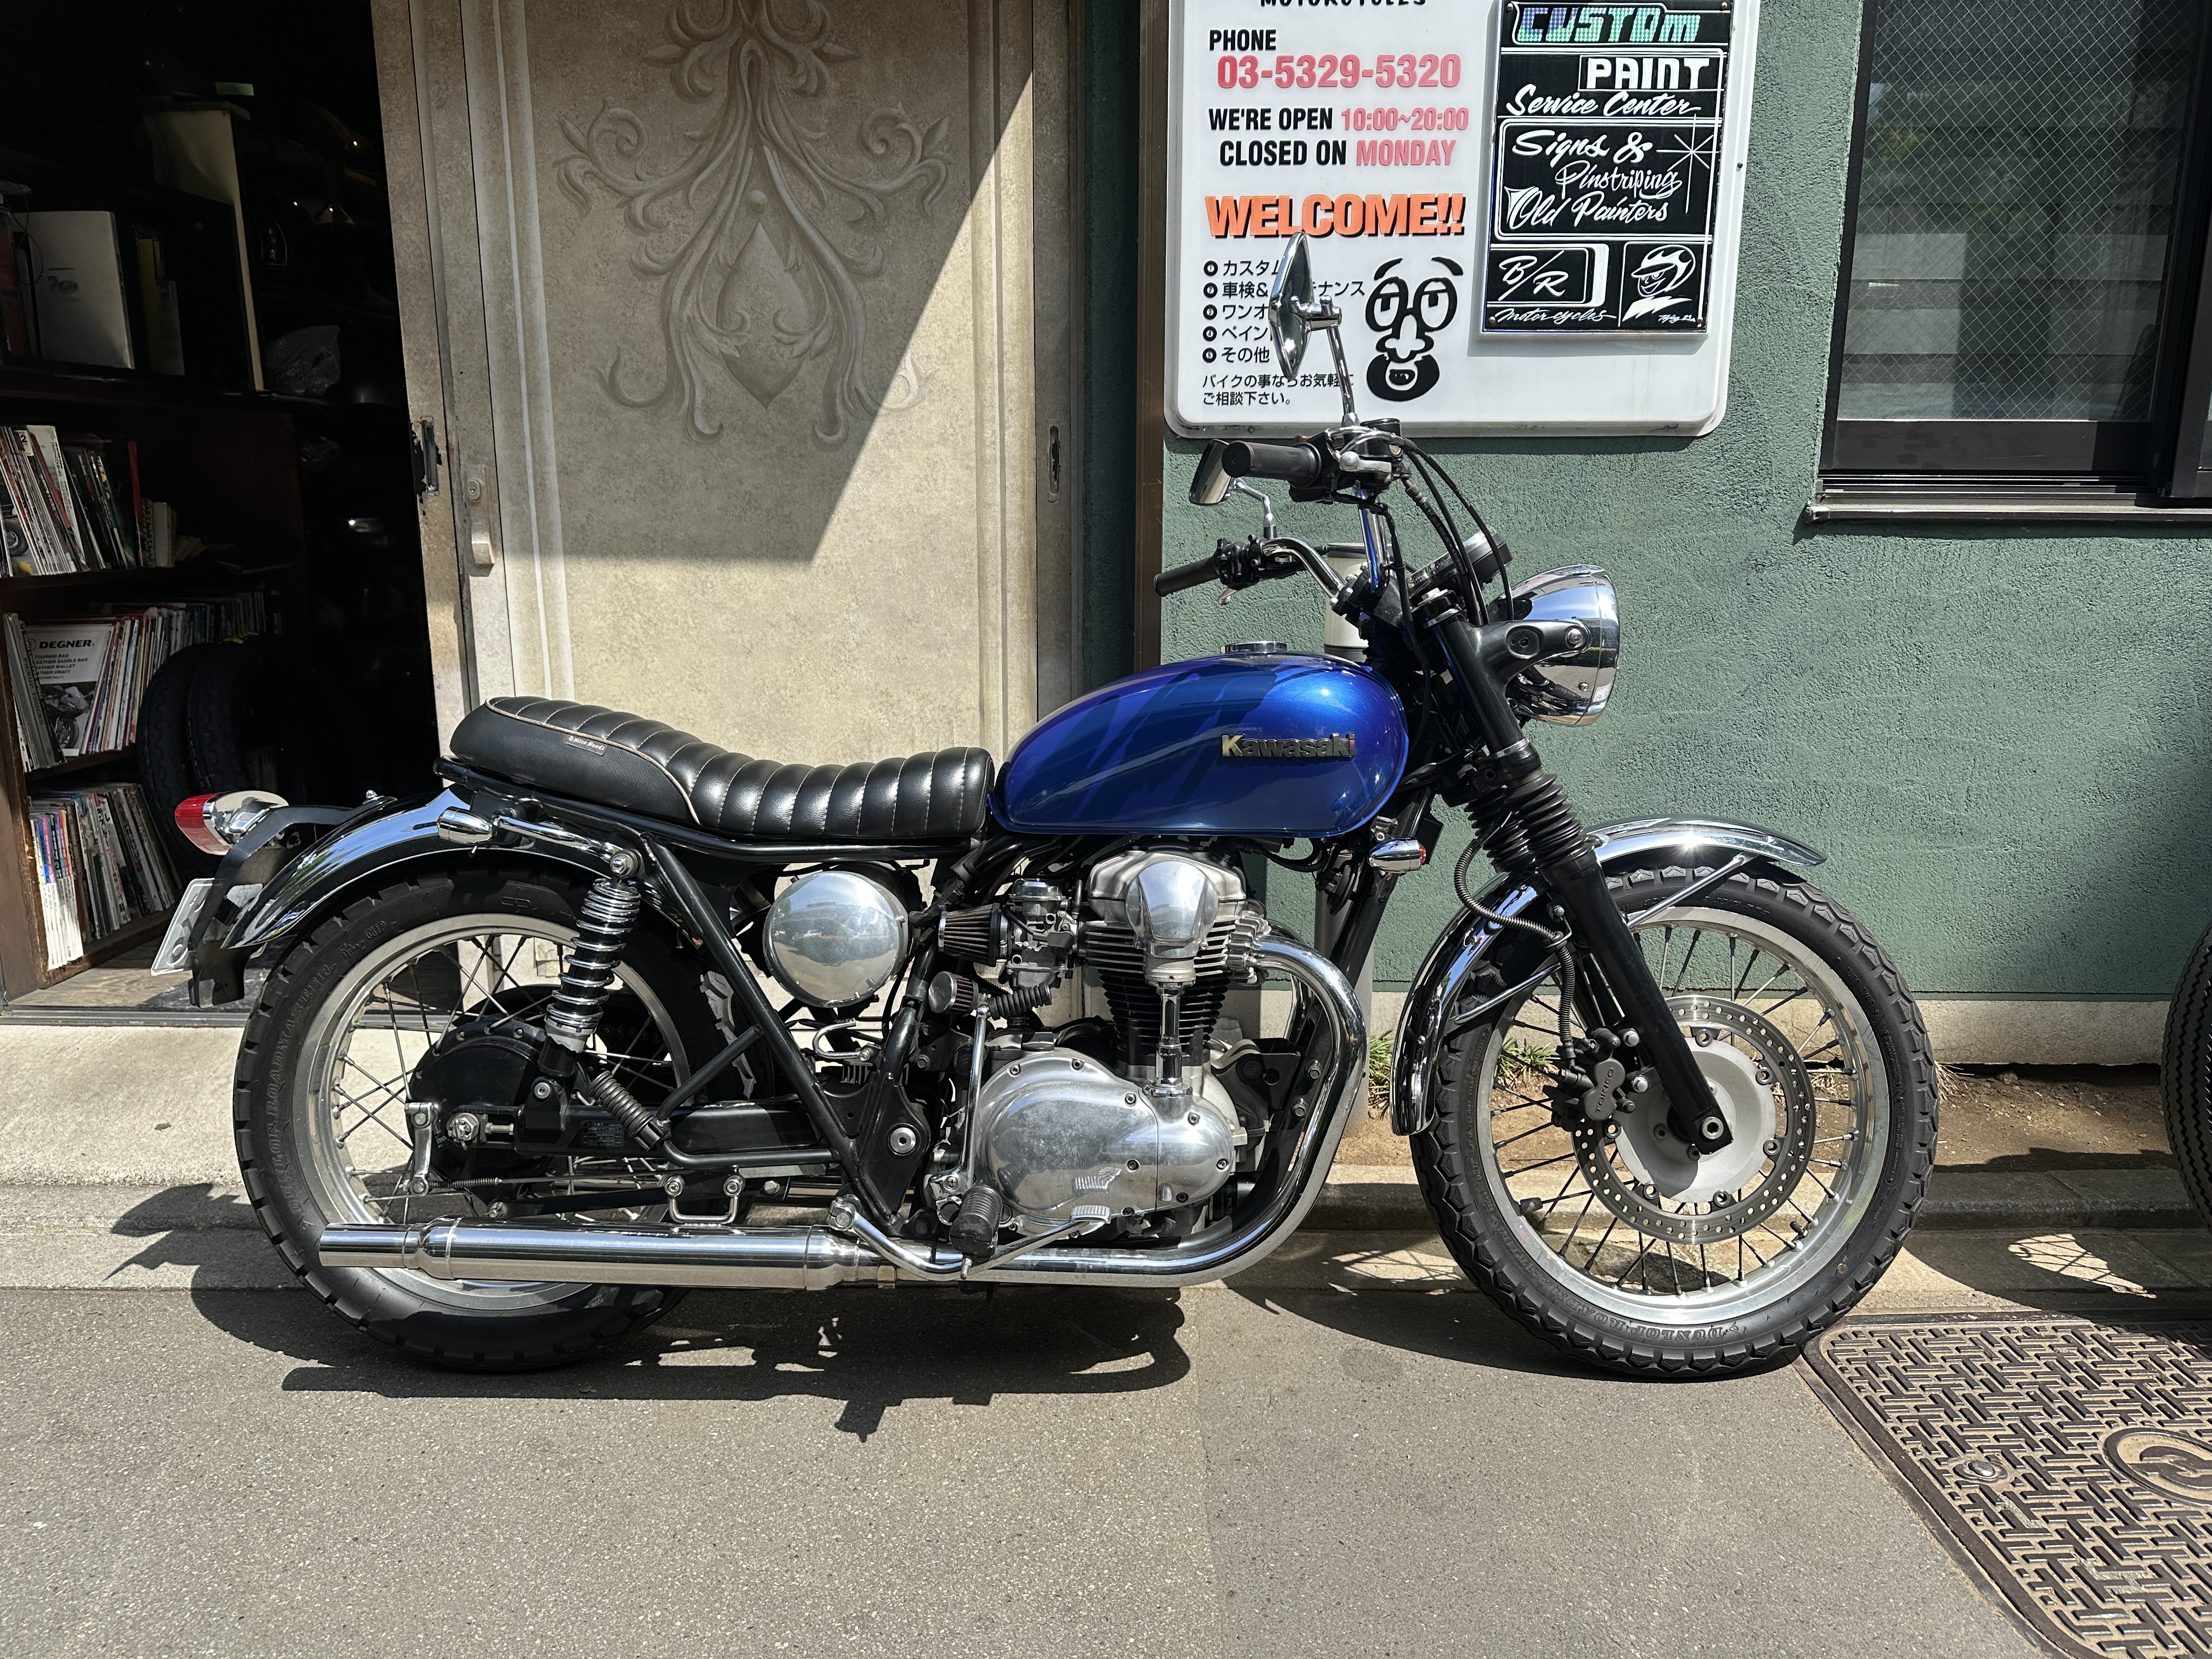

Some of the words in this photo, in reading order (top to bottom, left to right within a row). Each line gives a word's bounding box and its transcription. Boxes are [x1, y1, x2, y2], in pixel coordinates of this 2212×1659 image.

[1210, 29, 1277, 52] PHONE
[1217, 54, 1461, 88] 03-5329-5320
[1587, 57, 1709, 89] PAINT
[1506, 84, 1598, 116] Service
[1603, 91, 1702, 116] Center
[1209, 108, 1271, 131] WE'RE
[1279, 108, 1333, 130] OPEN
[1341, 108, 1469, 131] 10:00~20:00
[1220, 140, 1307, 166] CLOSED
[1316, 140, 1346, 166] ON
[1356, 140, 1456, 166] MONDAY
[1512, 129, 1610, 168] Signs
[1613, 132, 1654, 164] &
[1555, 161, 1683, 199] Pinstriping
[1205, 194, 1466, 238] WELCOME!!
[1508, 187, 1572, 229] Old
[1571, 190, 1668, 228] Painters
[1498, 250, 1569, 301] B/R
[1221, 346, 1270, 364] その他
[1203, 391, 1290, 406] ご相談下さい。
[39, 640, 92, 648] DEGNER
[24, 657, 35, 689] PICKUP
[32, 692, 44, 726] TRUCKS
[1222, 732, 1356, 758] Kawasaki
[1844, 966, 1861, 985] TUBE
[1859, 986, 1875, 1005] TYPE
[266, 964, 334, 1116] ROADMASTER
[1595, 1067, 1614, 1113] TOKICO
[267, 1122, 304, 1215] DUNLOP
[1630, 1325, 1724, 1341] DUNLOP
